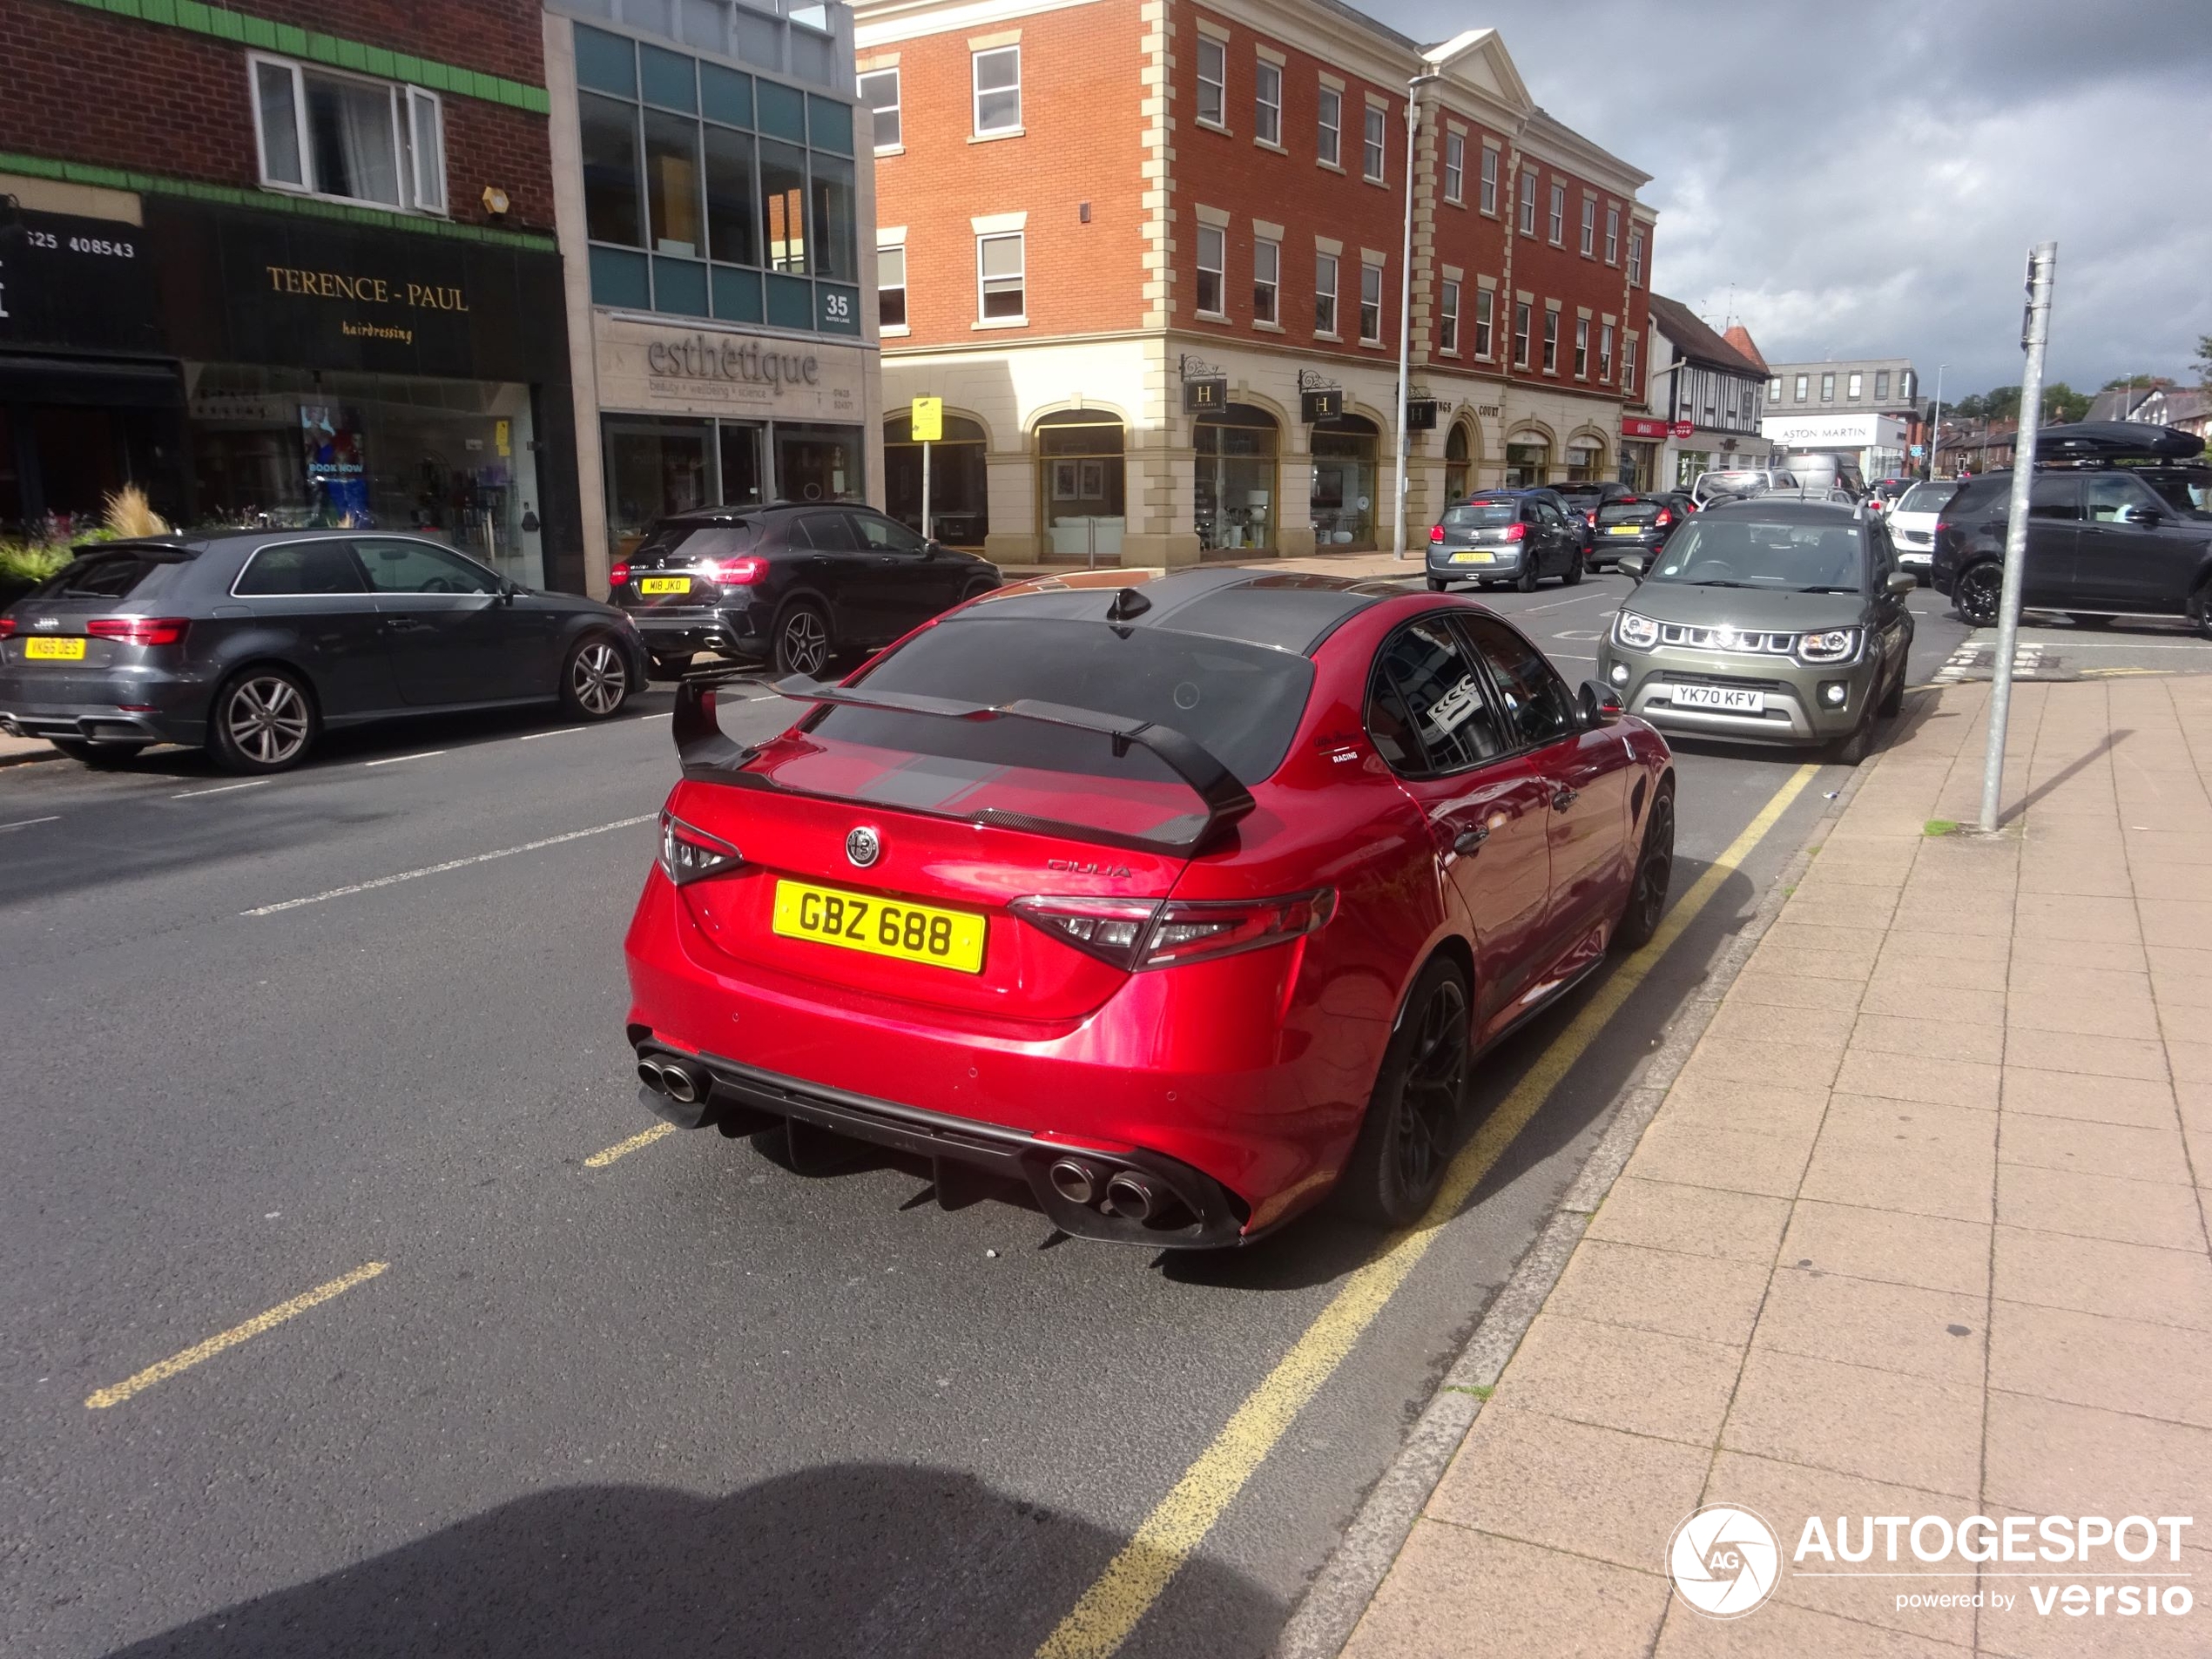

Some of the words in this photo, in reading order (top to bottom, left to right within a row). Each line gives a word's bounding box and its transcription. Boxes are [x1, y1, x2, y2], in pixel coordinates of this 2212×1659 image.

[69, 236, 135, 258] 408543
[266, 266, 388, 303] TERENCE
[407, 283, 469, 312] PAUL
[826, 294, 848, 317] 35
[342, 320, 413, 345] hairdressing
[649, 380, 679, 394] beauty
[690, 383, 729, 397] wellbeing
[738, 386, 767, 400] science
[1197, 386, 1212, 402] H
[1316, 396, 1328, 413] H
[1479, 405, 1500, 417] COURT
[1783, 428, 1817, 439] ASTON
[1822, 428, 1866, 438] MARTIN
[308, 463, 338, 473] BOOK
[339, 463, 364, 474] NOW
[664, 578, 681, 591] JKD
[1680, 686, 1721, 705] YK70
[1724, 691, 1757, 708] KFV
[1332, 752, 1358, 764] RACING
[1047, 859, 1132, 879] GIULIA
[799, 891, 870, 941] GBZ
[878, 906, 953, 956] 688
